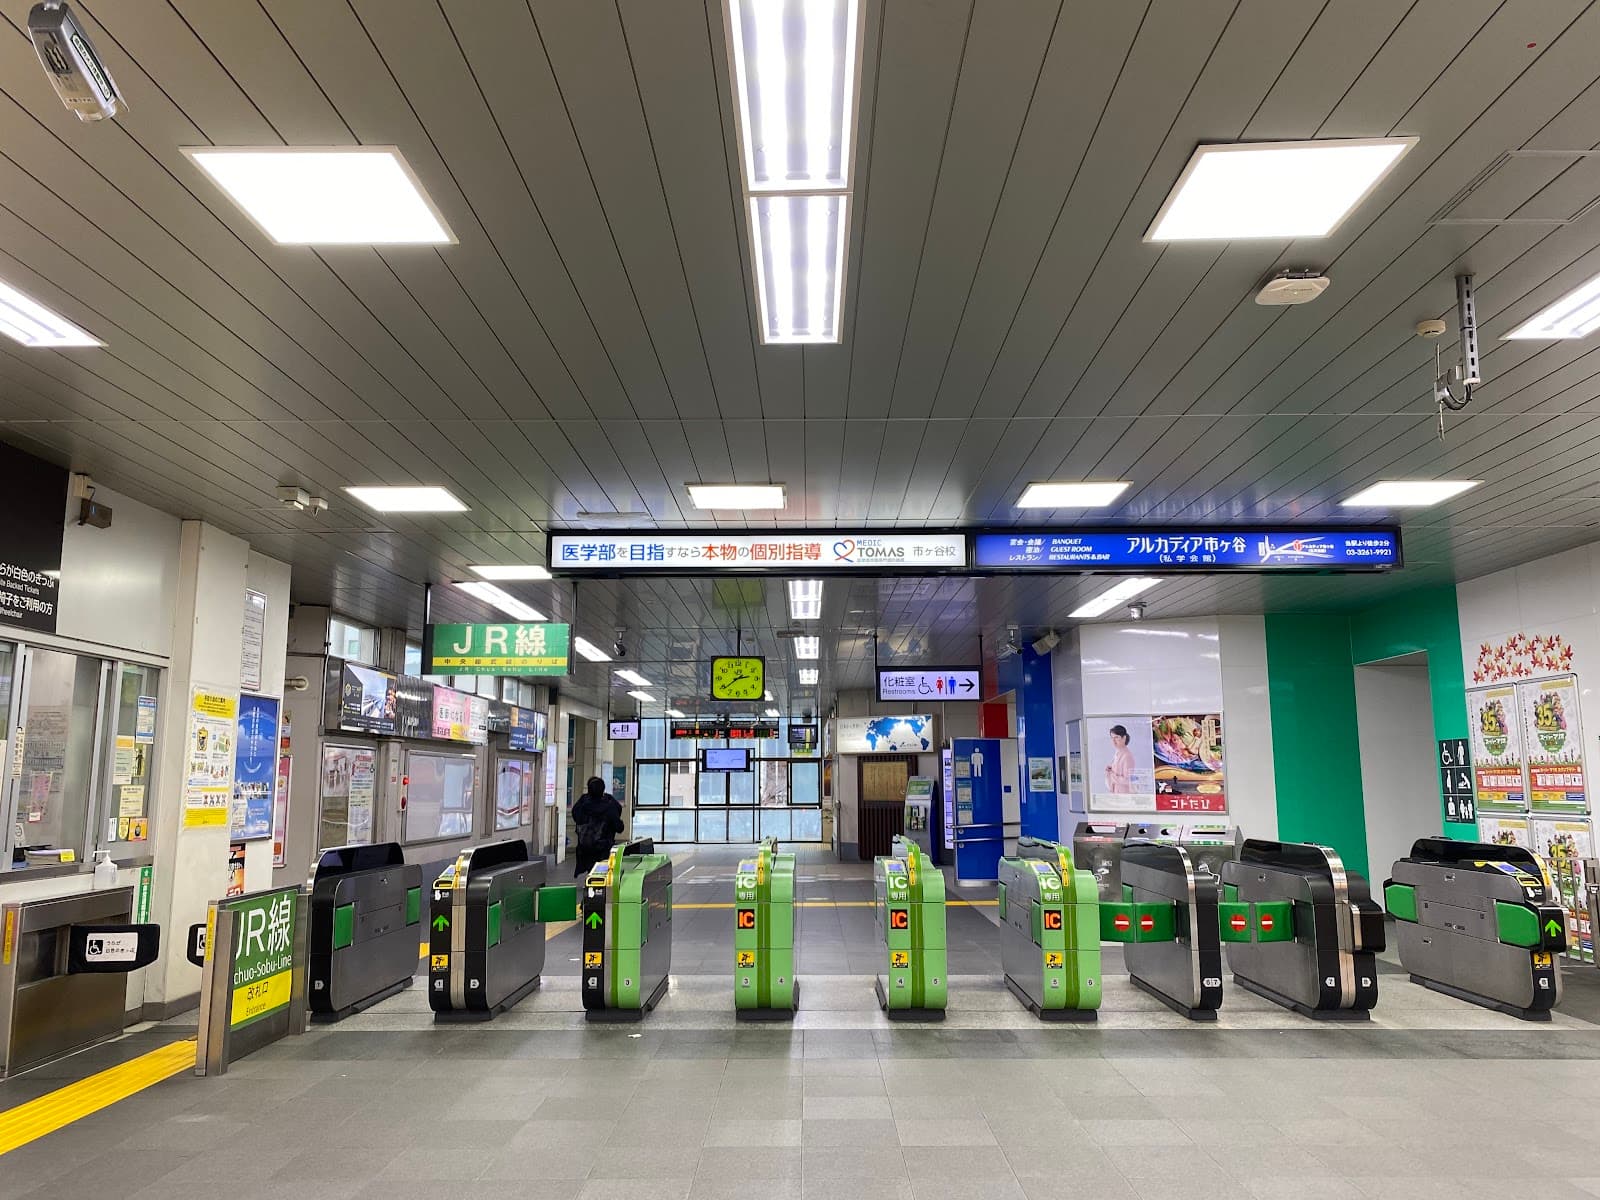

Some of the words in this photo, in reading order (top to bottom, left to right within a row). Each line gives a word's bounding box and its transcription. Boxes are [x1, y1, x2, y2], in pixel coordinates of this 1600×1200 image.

[856, 539, 882, 547] MEDIC
[562, 543, 822, 561] 医学部を目指すなら本物の個別指導
[857, 547, 905, 557] TOMAS
[738, 875, 757, 889] IC
[889, 876, 907, 889] IC
[1040, 877, 1060, 890] IC
[235, 894, 291, 960] JR線
[739, 911, 754, 928] IC
[891, 911, 907, 928] IC
[1045, 912, 1061, 928] IC
[245, 1002, 267, 1017] Entrance
